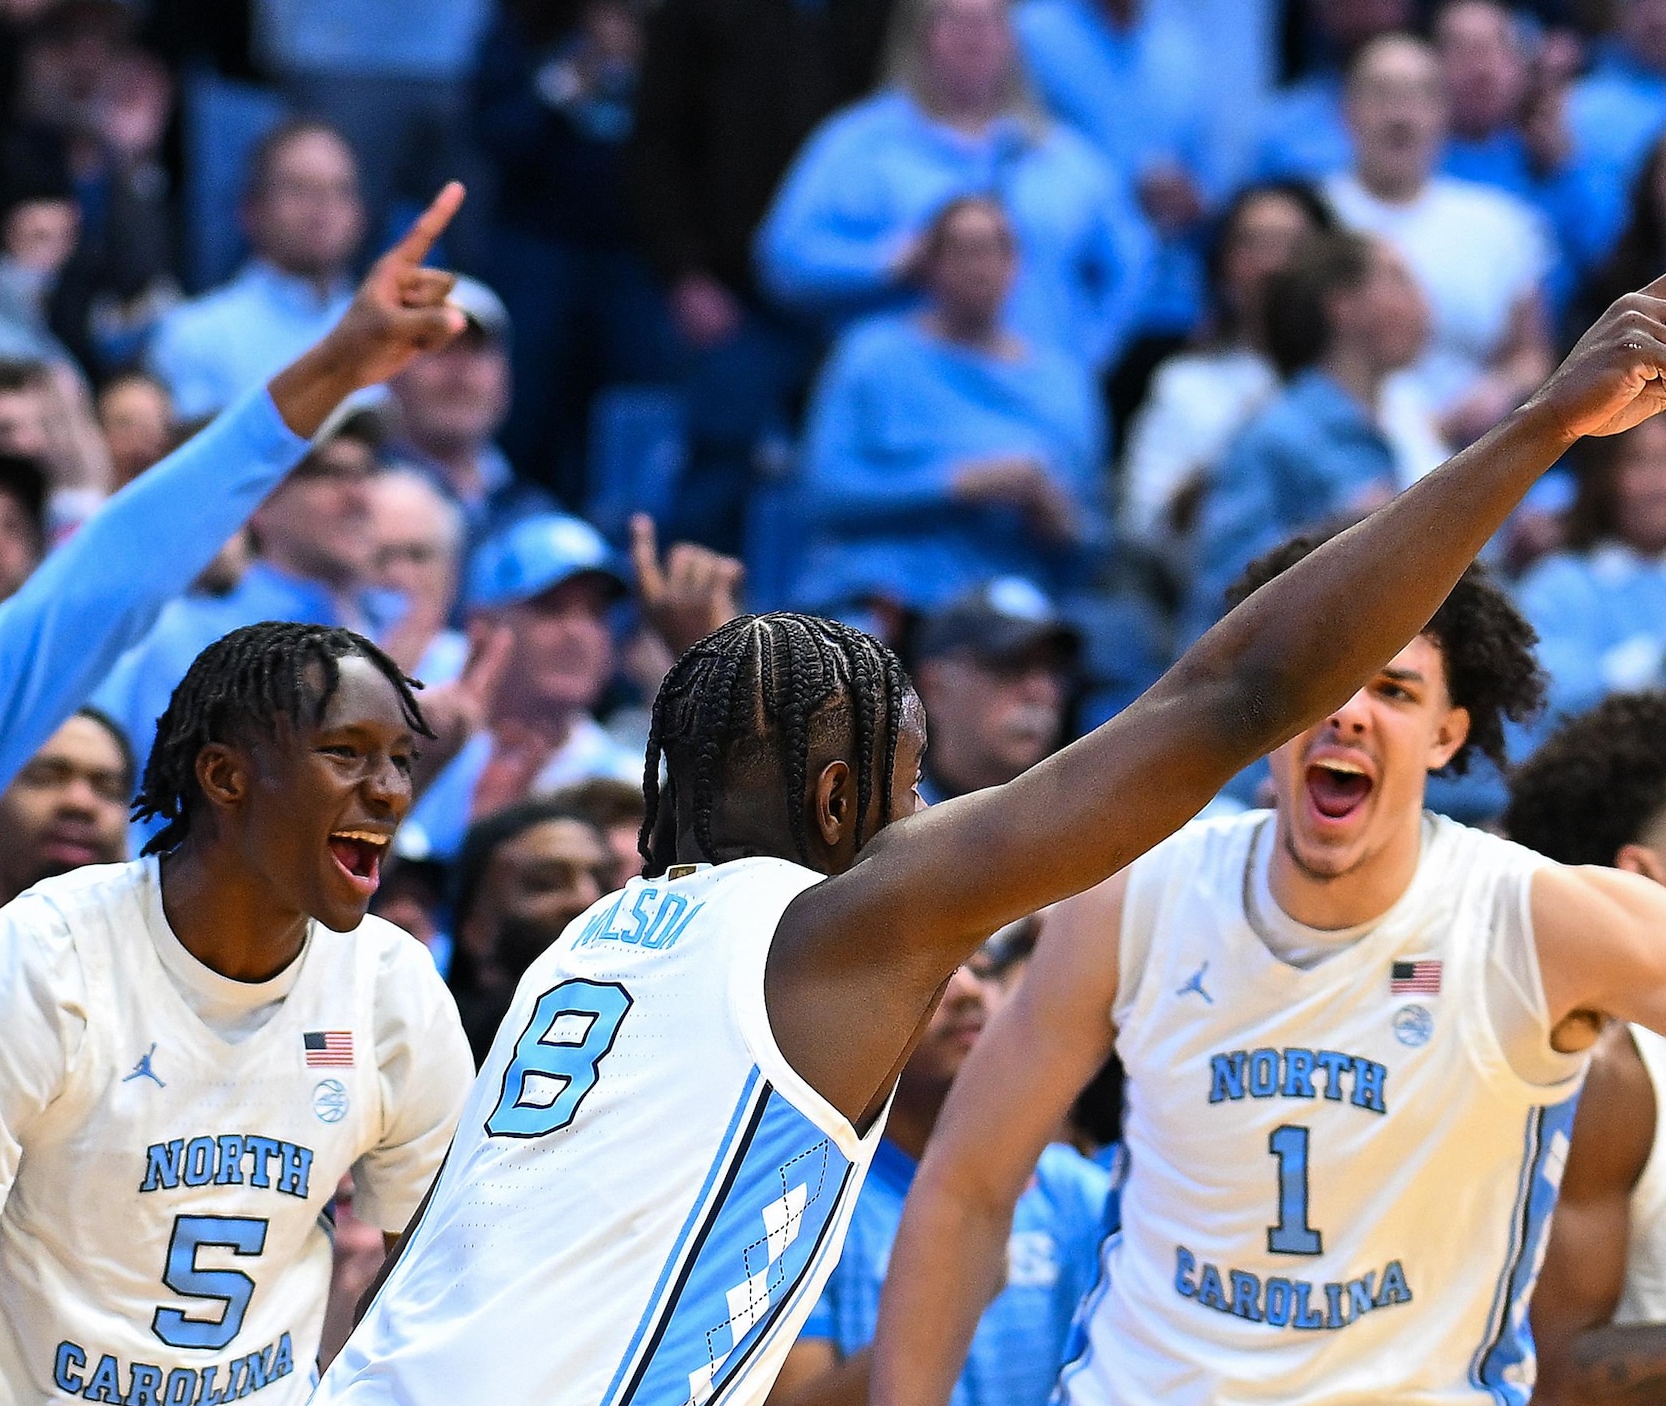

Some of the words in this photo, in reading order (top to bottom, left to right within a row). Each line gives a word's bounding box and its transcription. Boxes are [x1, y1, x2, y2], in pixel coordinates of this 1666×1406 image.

[484, 977, 634, 1139] 8
[1208, 1047, 1387, 1114] NORTH
[140, 1134, 314, 1199] NORTH
[1268, 1123, 1323, 1255] 1
[151, 1214, 269, 1350] 5
[1174, 1244, 1413, 1330] CAROLINA
